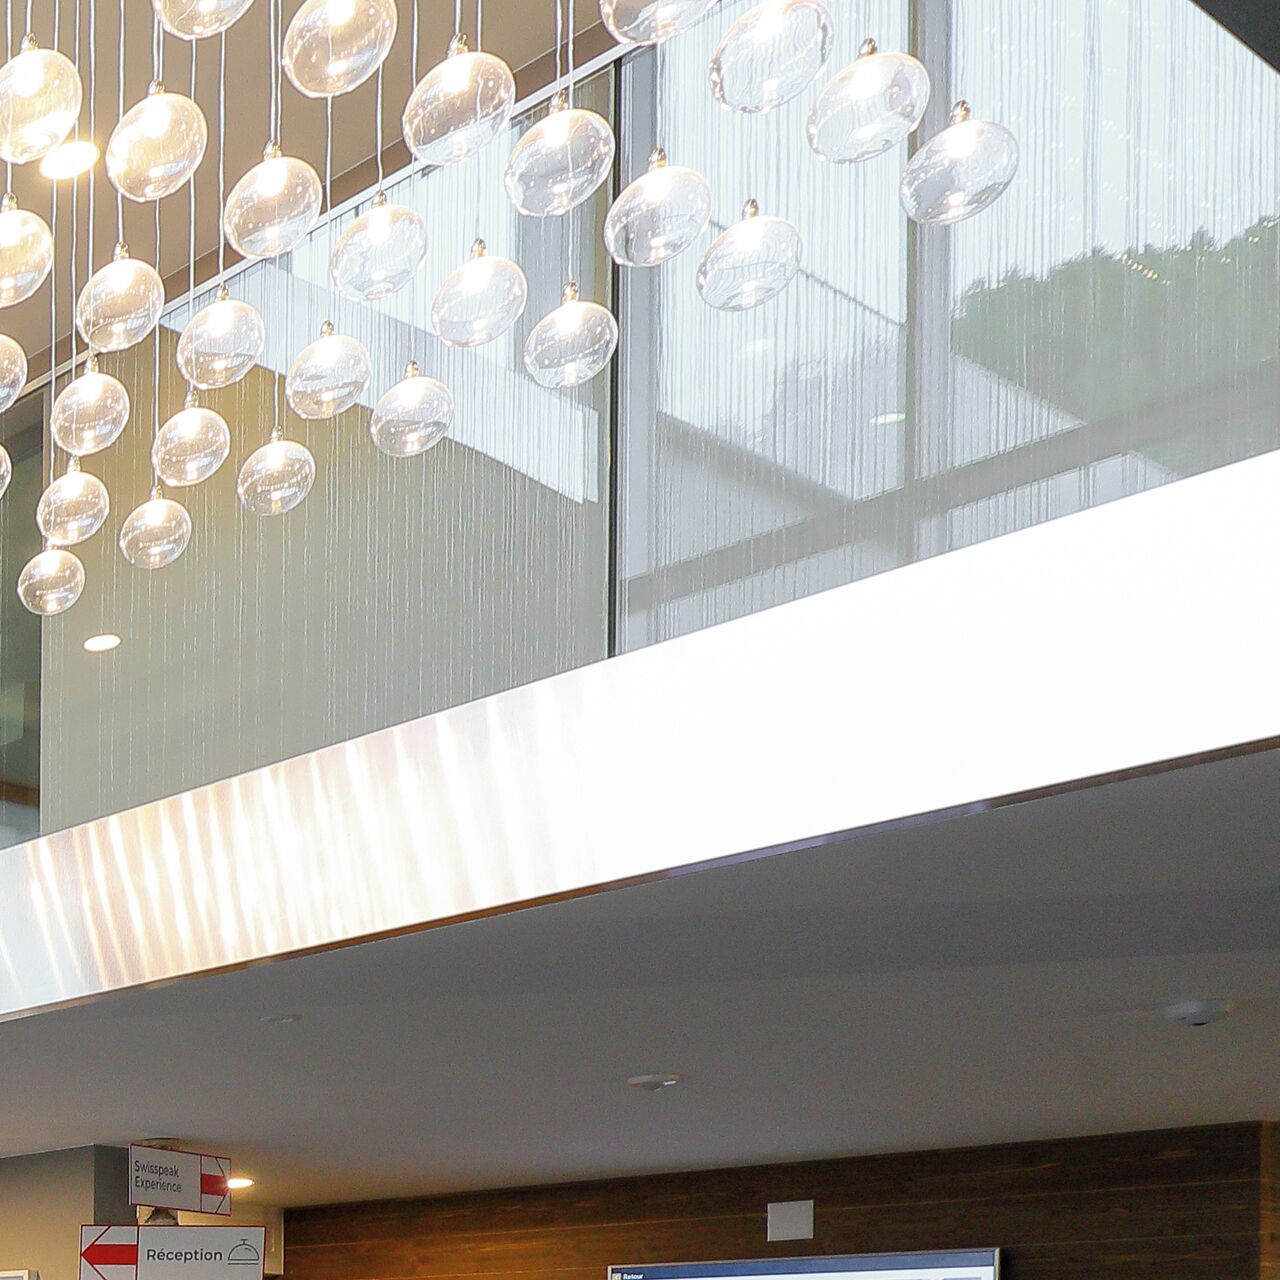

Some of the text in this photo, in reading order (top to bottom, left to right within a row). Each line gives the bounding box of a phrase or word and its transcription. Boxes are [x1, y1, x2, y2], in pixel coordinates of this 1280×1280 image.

[134, 1160, 180, 1178] Swisspeak
[134, 1176, 182, 1193] Experience
[145, 1247, 223, 1266] Réception
